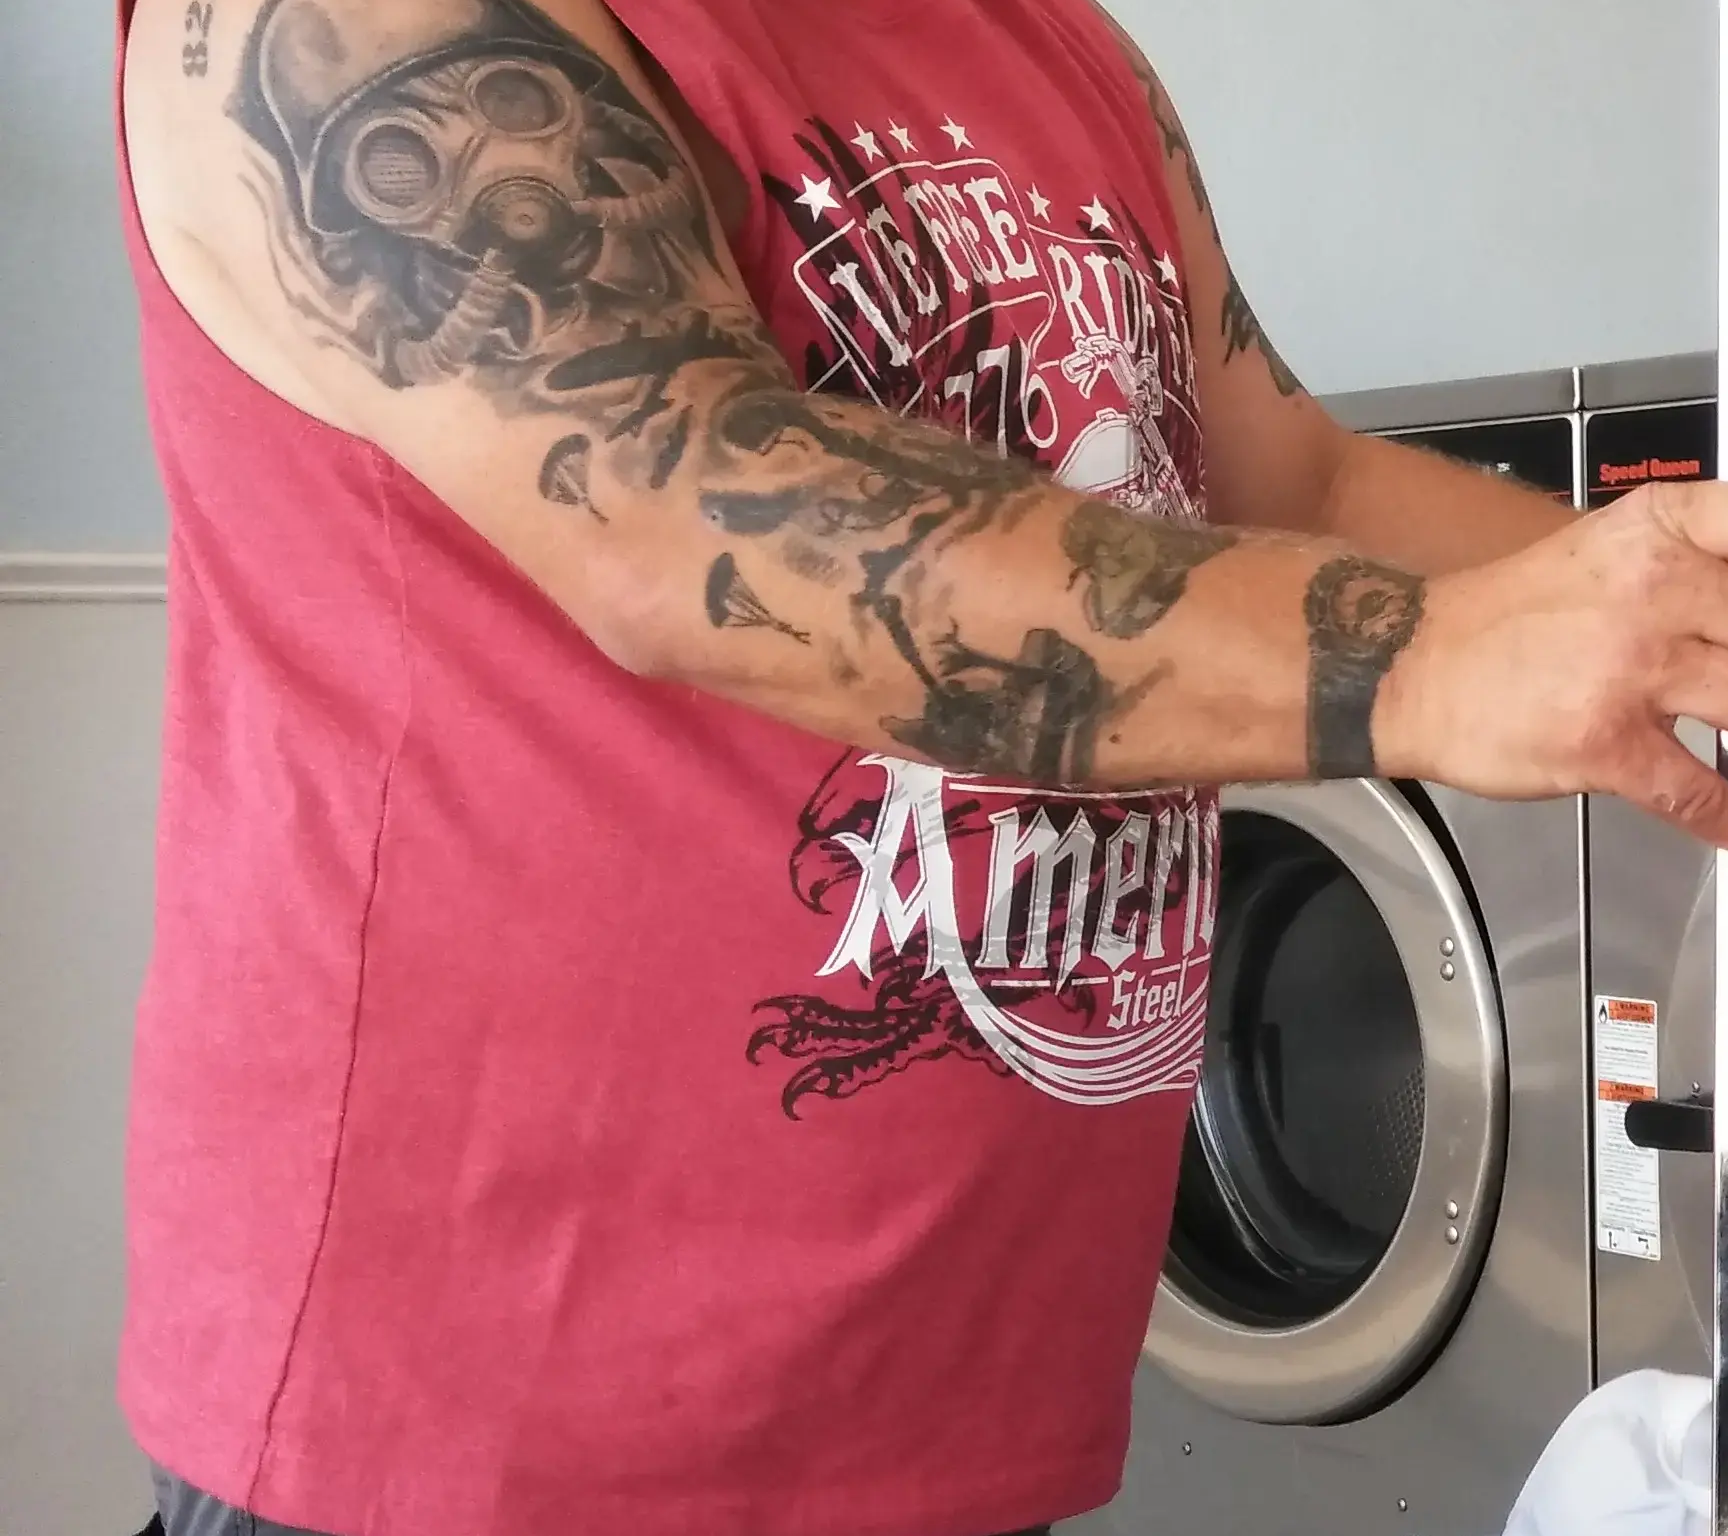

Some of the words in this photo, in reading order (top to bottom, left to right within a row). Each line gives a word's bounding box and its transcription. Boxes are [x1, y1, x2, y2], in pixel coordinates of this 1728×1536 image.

[902, 176, 1039, 296] FREE
[1599, 459, 1648, 485] Speed
[1649, 456, 1700, 478] Queen
[1106, 961, 1189, 1031] Steel
